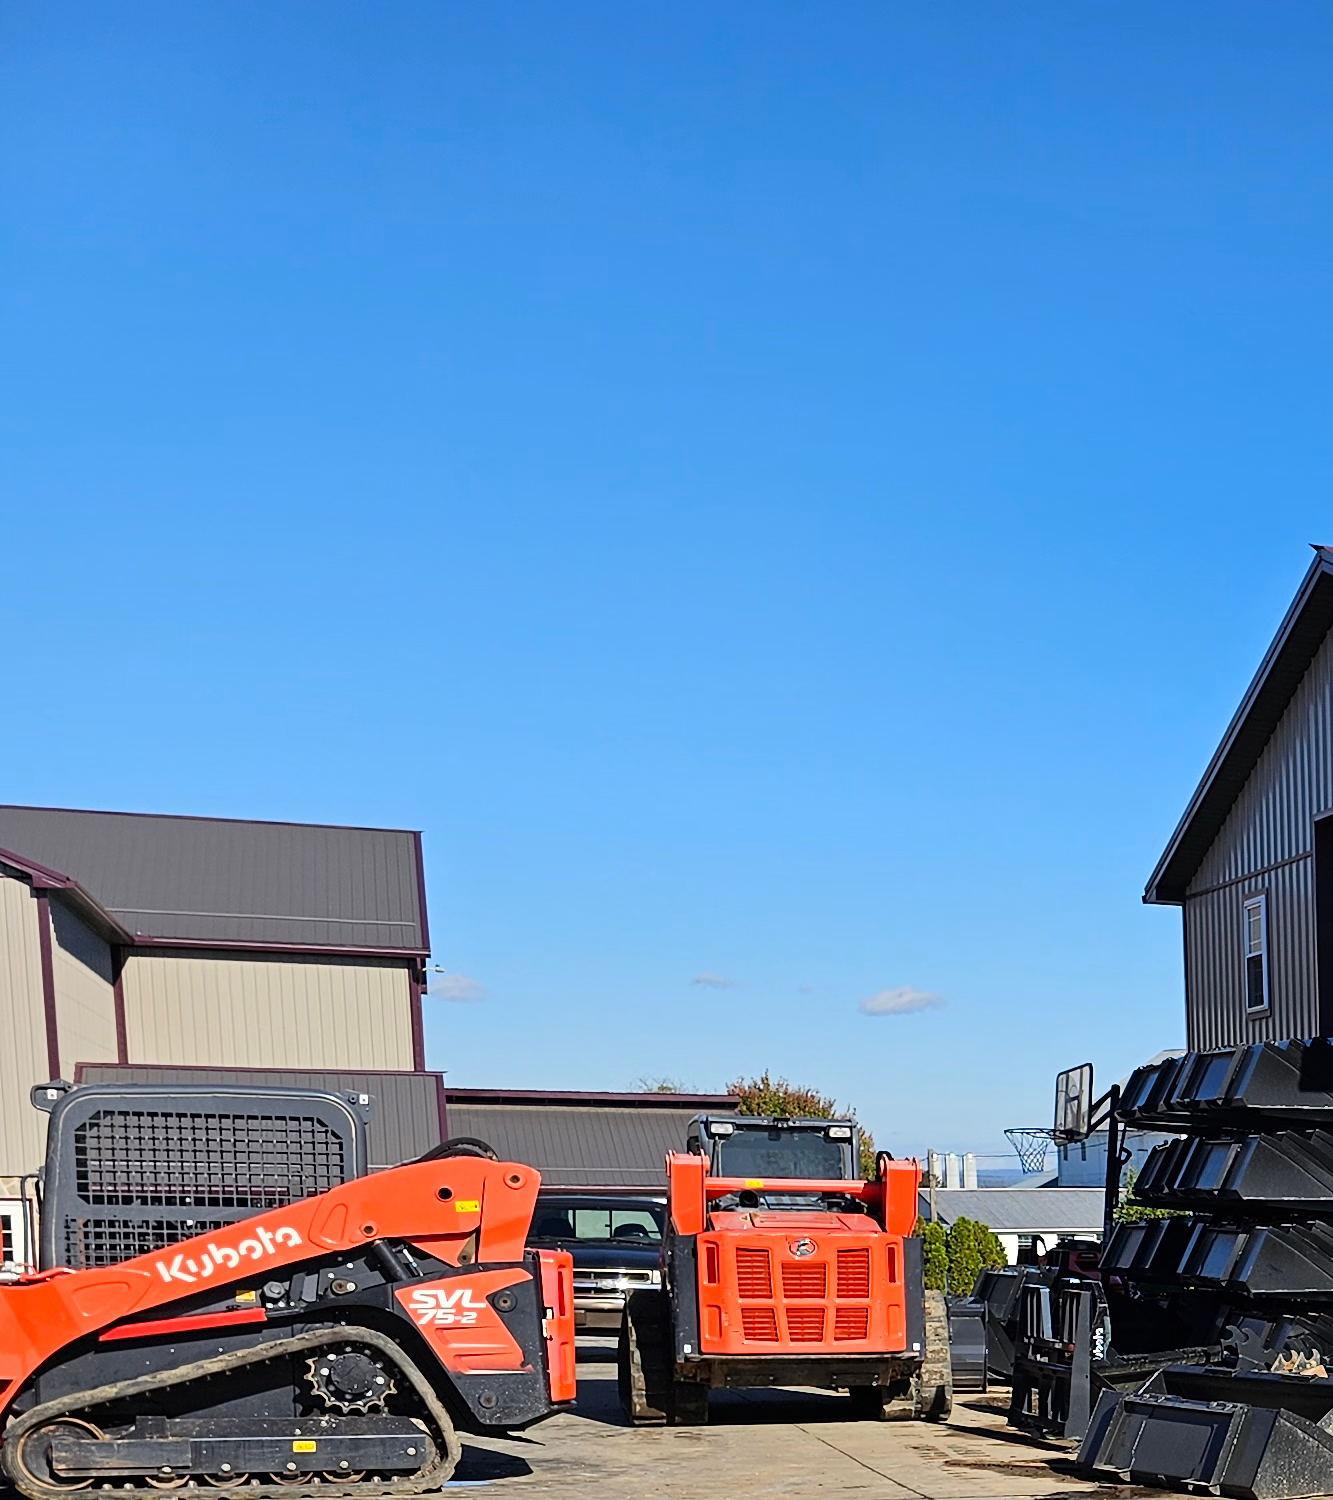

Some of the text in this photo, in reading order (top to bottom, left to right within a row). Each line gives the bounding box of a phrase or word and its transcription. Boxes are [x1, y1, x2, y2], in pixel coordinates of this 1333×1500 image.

[155, 1226, 303, 1283] Kubota
[408, 1289, 487, 1309] SVL
[416, 1308, 478, 1325] 75-2
[1092, 1327, 1104, 1361] ubota
